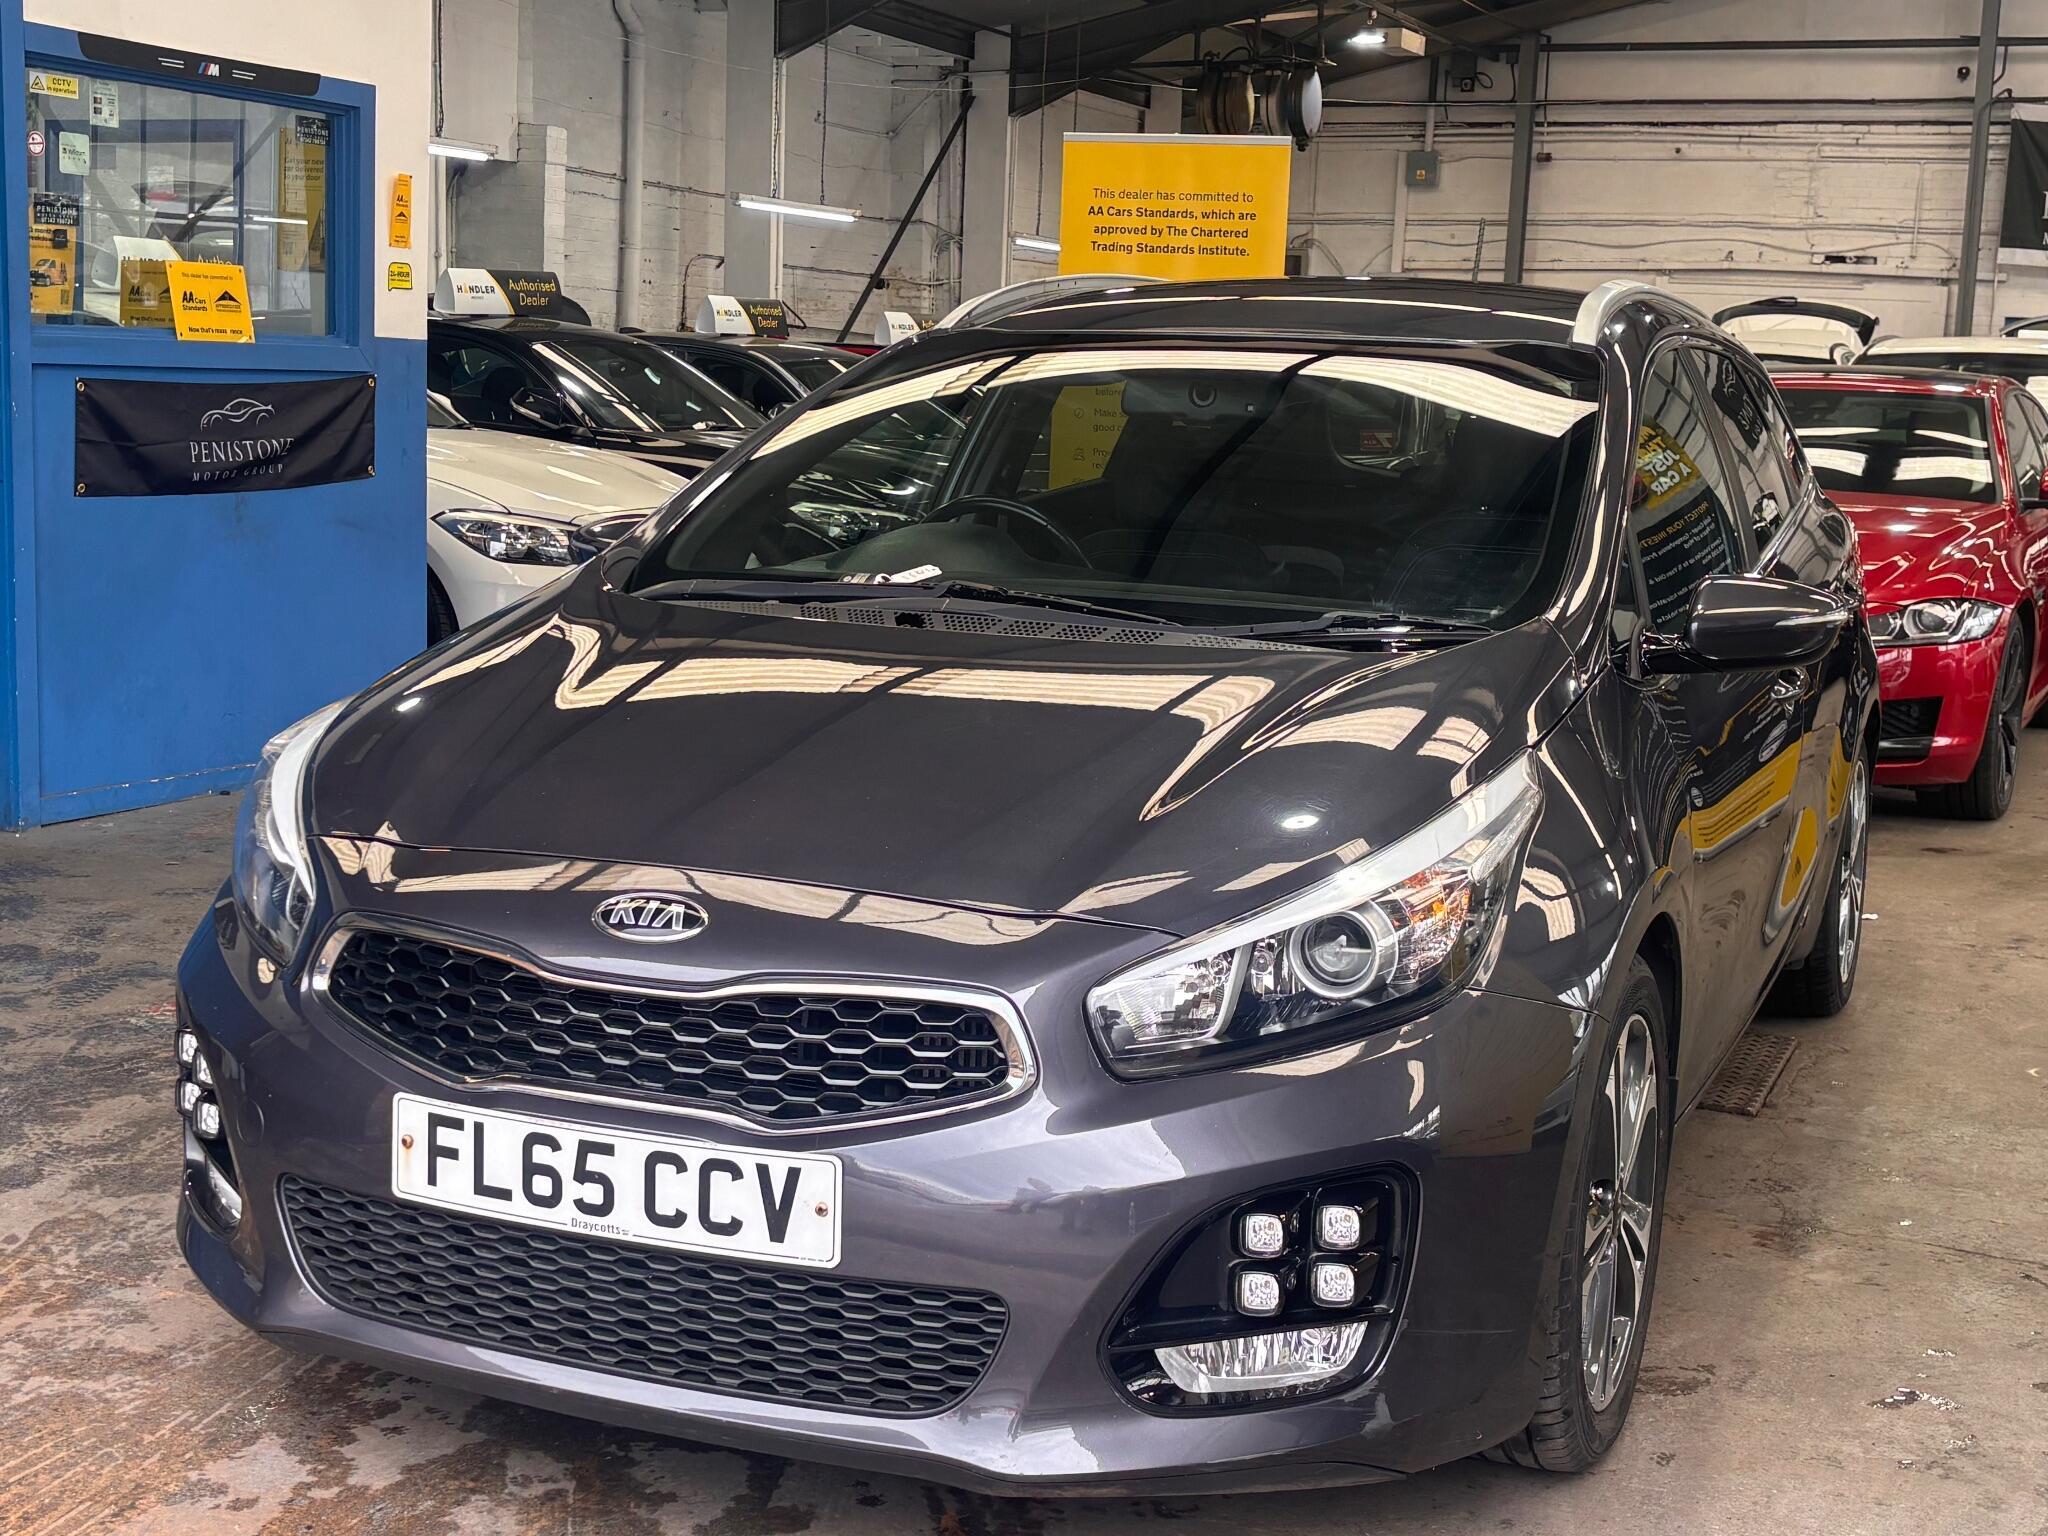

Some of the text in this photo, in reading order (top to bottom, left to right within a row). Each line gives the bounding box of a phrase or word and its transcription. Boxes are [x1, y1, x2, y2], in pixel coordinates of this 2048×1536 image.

[52, 77, 72, 87] CCTV
[1093, 187, 1254, 203] This dealer has committed to
[36, 205, 78, 216] PENISTONE
[1088, 206, 1257, 221] AA Cars Standards, which are
[1093, 224, 1248, 238] approved by The Chartered
[1091, 241, 1250, 257] Trading Standards Institute.
[509, 279, 556, 292] Authorised
[182, 291, 195, 304] AA
[520, 292, 549, 306] Dealer
[182, 304, 208, 312] Standards
[750, 304, 783, 316] Authorised
[757, 316, 779, 328] Dealer
[1094, 408, 1117, 418] Make
[1092, 424, 1116, 433] good
[189, 438, 295, 463] PENISTONE
[192, 463, 284, 482] MOTOR GROUP
[609, 898, 686, 931] KIA
[427, 1111, 802, 1244] FL65 CCV
[571, 1217, 621, 1235] Draycotts
